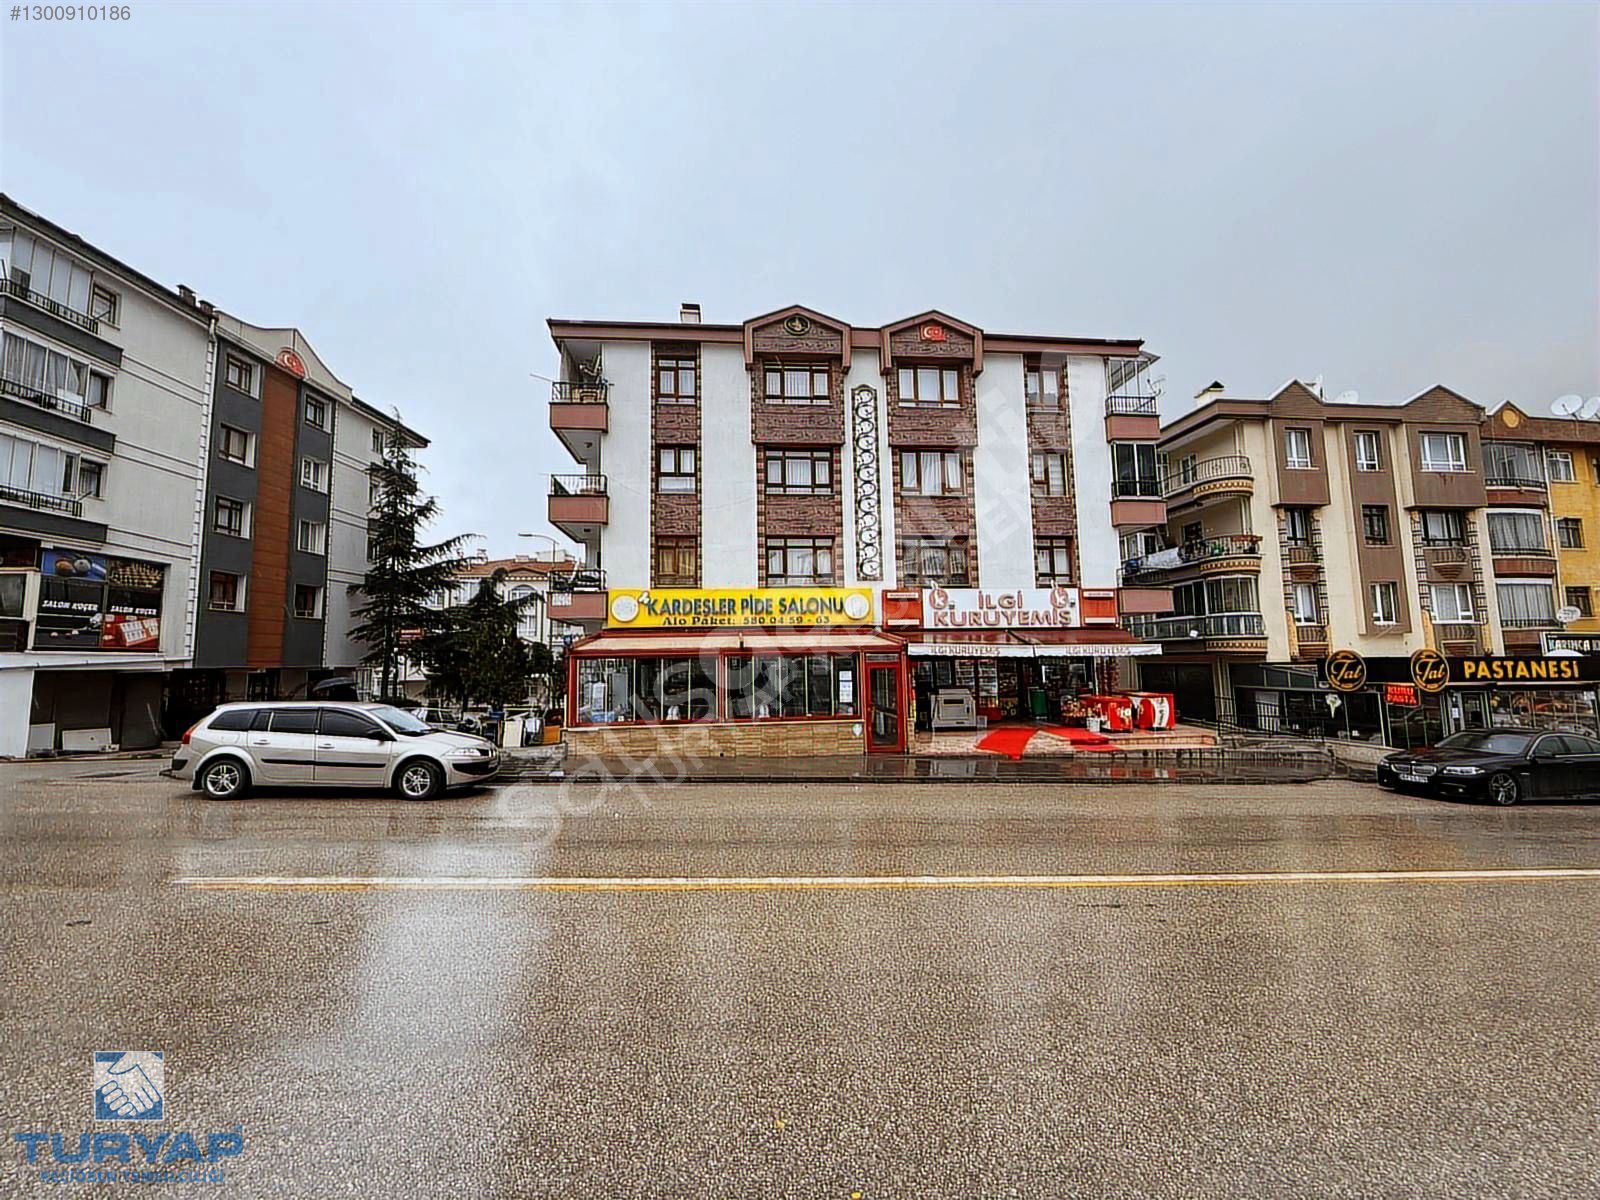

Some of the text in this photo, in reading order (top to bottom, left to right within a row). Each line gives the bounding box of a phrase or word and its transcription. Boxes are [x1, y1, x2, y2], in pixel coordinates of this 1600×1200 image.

[740, 593, 773, 615] PİDE
[778, 597, 844, 615] SALONU
[978, 590, 1023, 609] İLGİ
[663, 616, 687, 625] Alo
[934, 608, 1072, 627] KURUYEMİŞ
[1463, 660, 1580, 679] PASTANESİ
